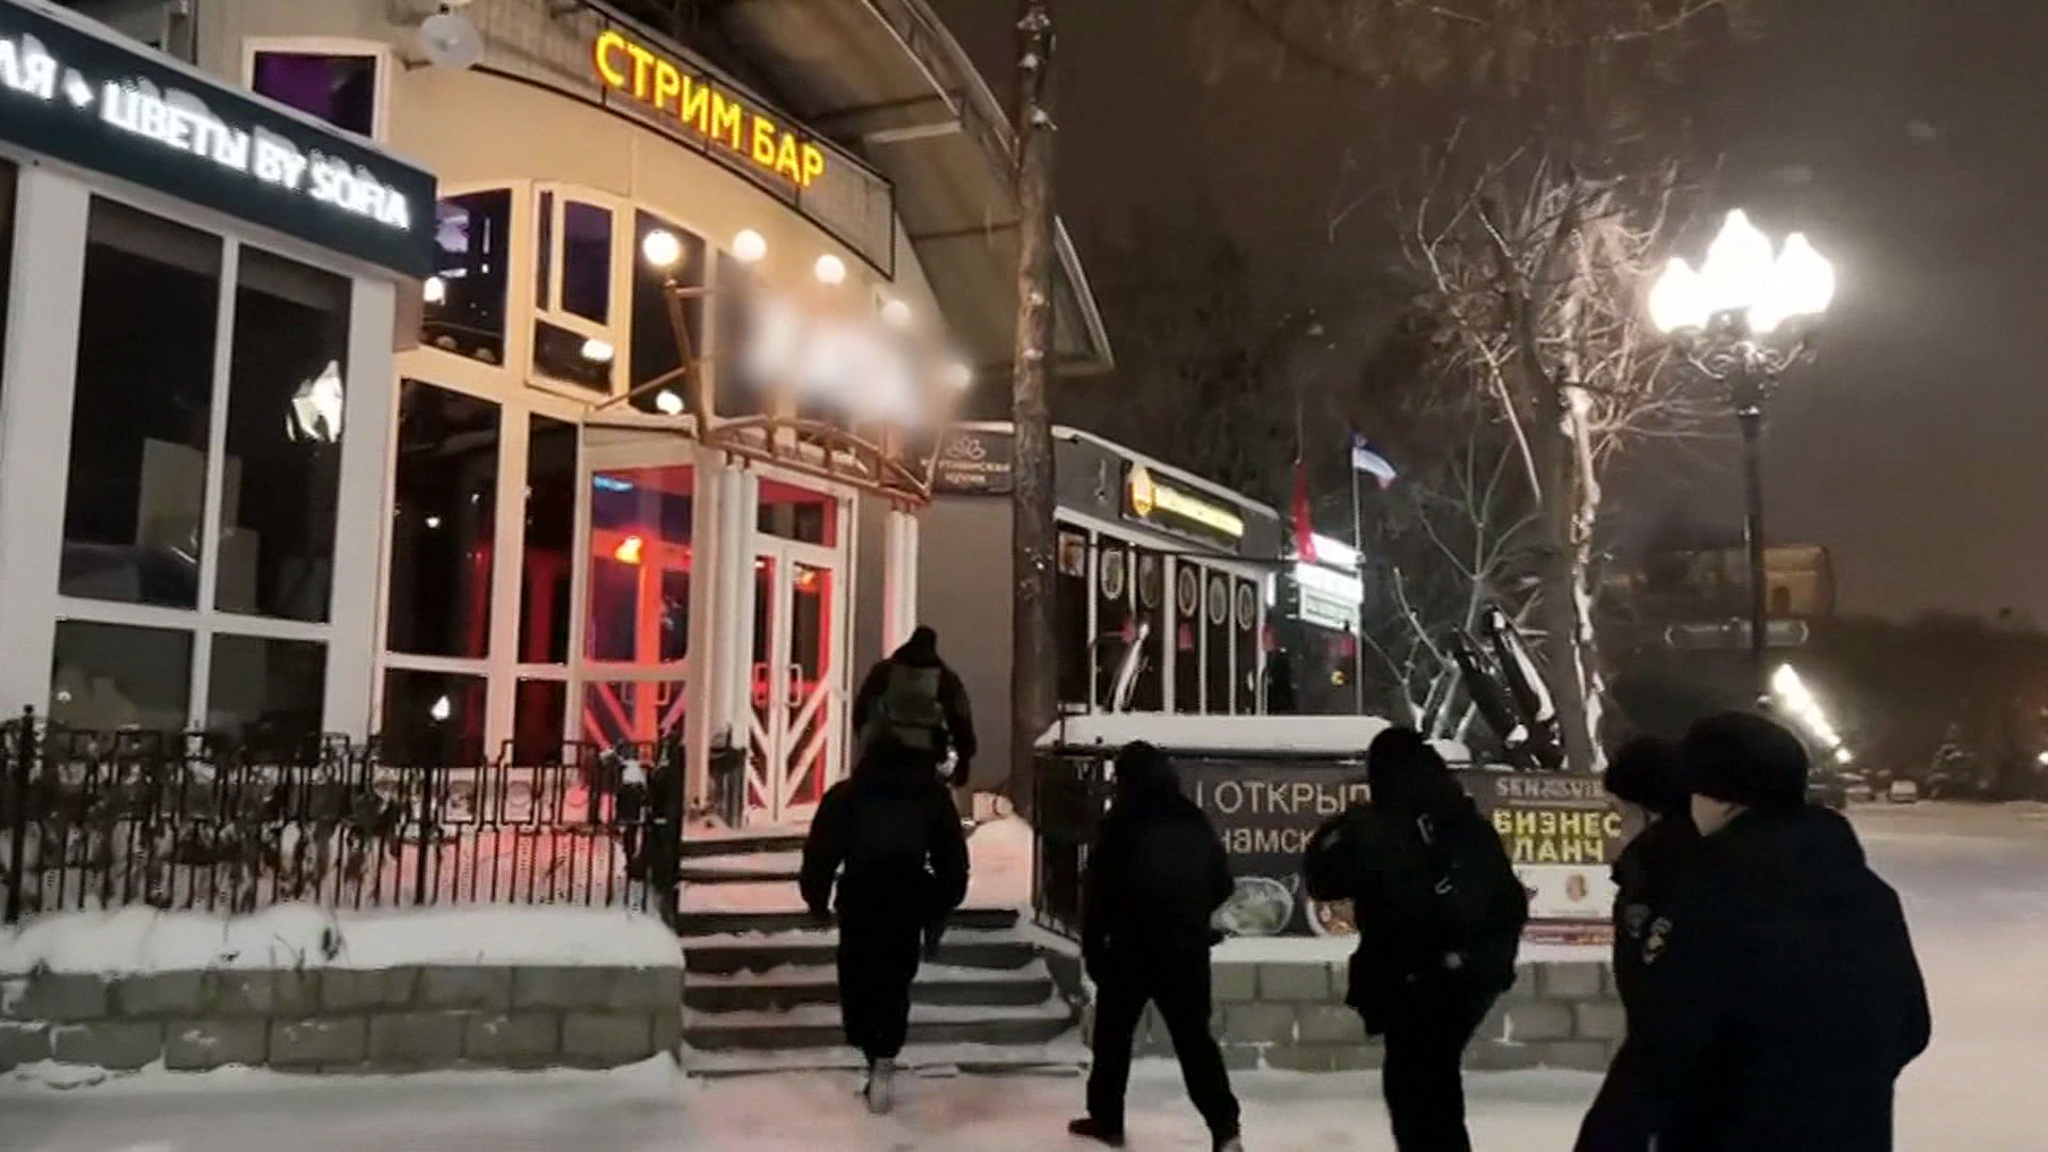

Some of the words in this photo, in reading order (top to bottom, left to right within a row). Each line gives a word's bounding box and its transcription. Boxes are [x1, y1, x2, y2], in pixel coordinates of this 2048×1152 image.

[595, 31, 742, 150] СТРИМ
[752, 117, 825, 186] БАР
[101, 81, 250, 171] ЦВЕТЫ
[253, 134, 306, 190] BY
[308, 160, 411, 231] SOFIA
[1492, 808, 1622, 838] БИЗНЕС
[1513, 837, 1604, 862] ЛАНЧ
